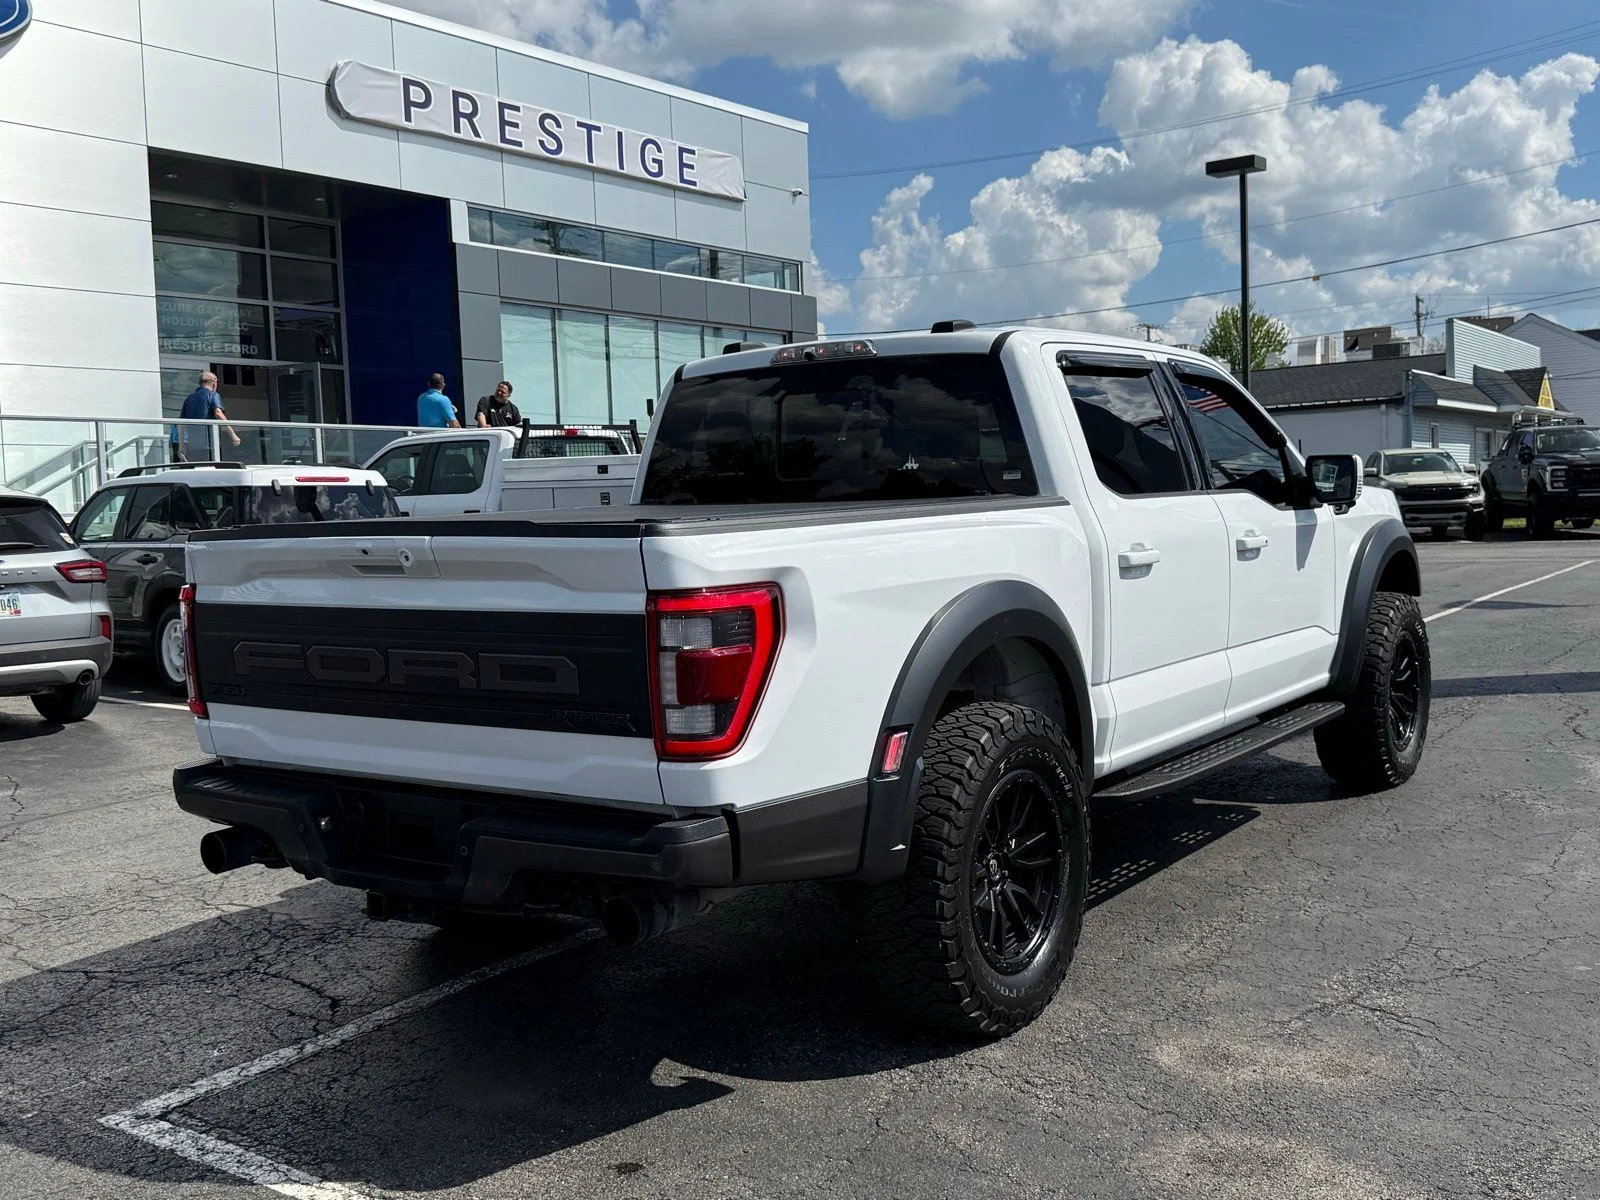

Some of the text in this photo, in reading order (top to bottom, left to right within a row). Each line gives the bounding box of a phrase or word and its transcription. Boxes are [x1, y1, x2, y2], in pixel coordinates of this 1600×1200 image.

[402, 76, 698, 188] PRESTIGE
[158, 301, 193, 313] ZURE
[224, 342, 258, 355] FORD
[233, 641, 579, 696] FORD
